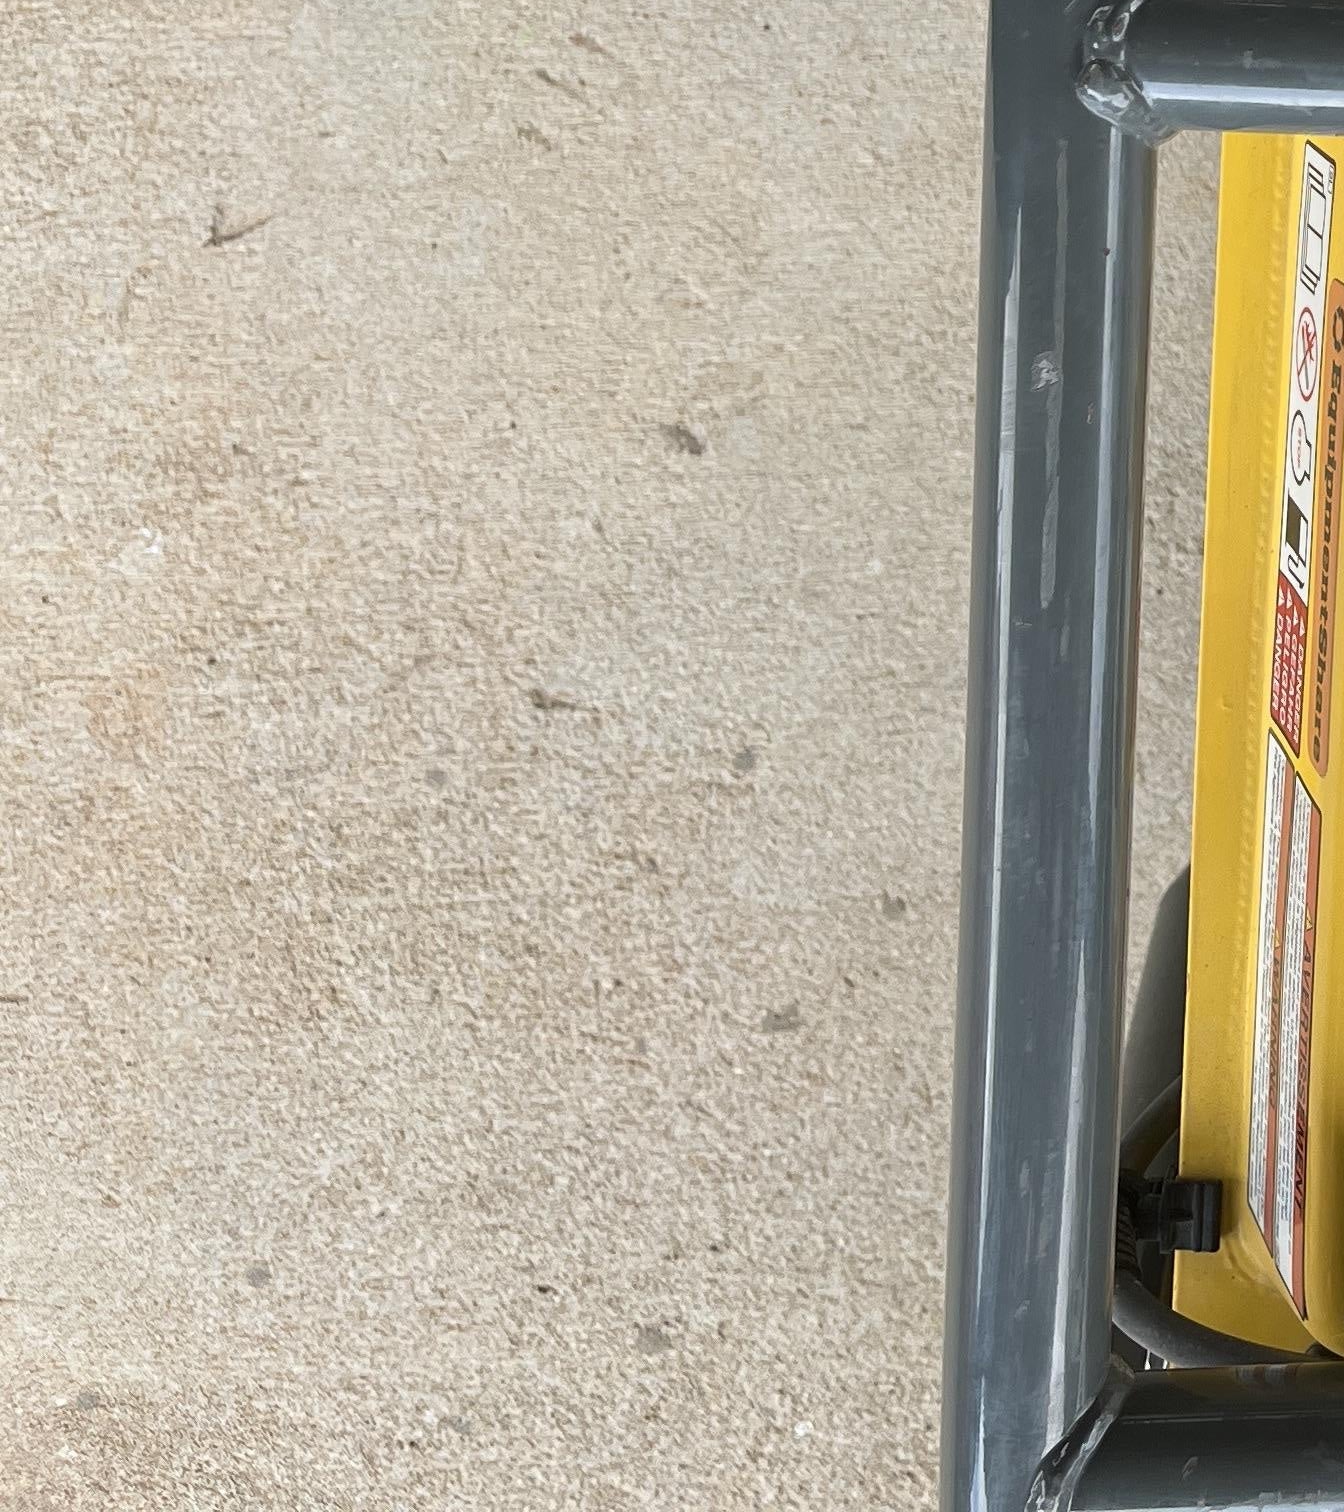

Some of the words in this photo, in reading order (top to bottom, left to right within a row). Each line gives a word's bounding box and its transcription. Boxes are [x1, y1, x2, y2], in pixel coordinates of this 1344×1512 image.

[1312, 362, 1342, 763] EquipmentShare
[1272, 612, 1281, 711] DANGER
[1280, 615, 1291, 726] PELIGRO
[1295, 940, 1311, 1216] AVERTISSEMENT
